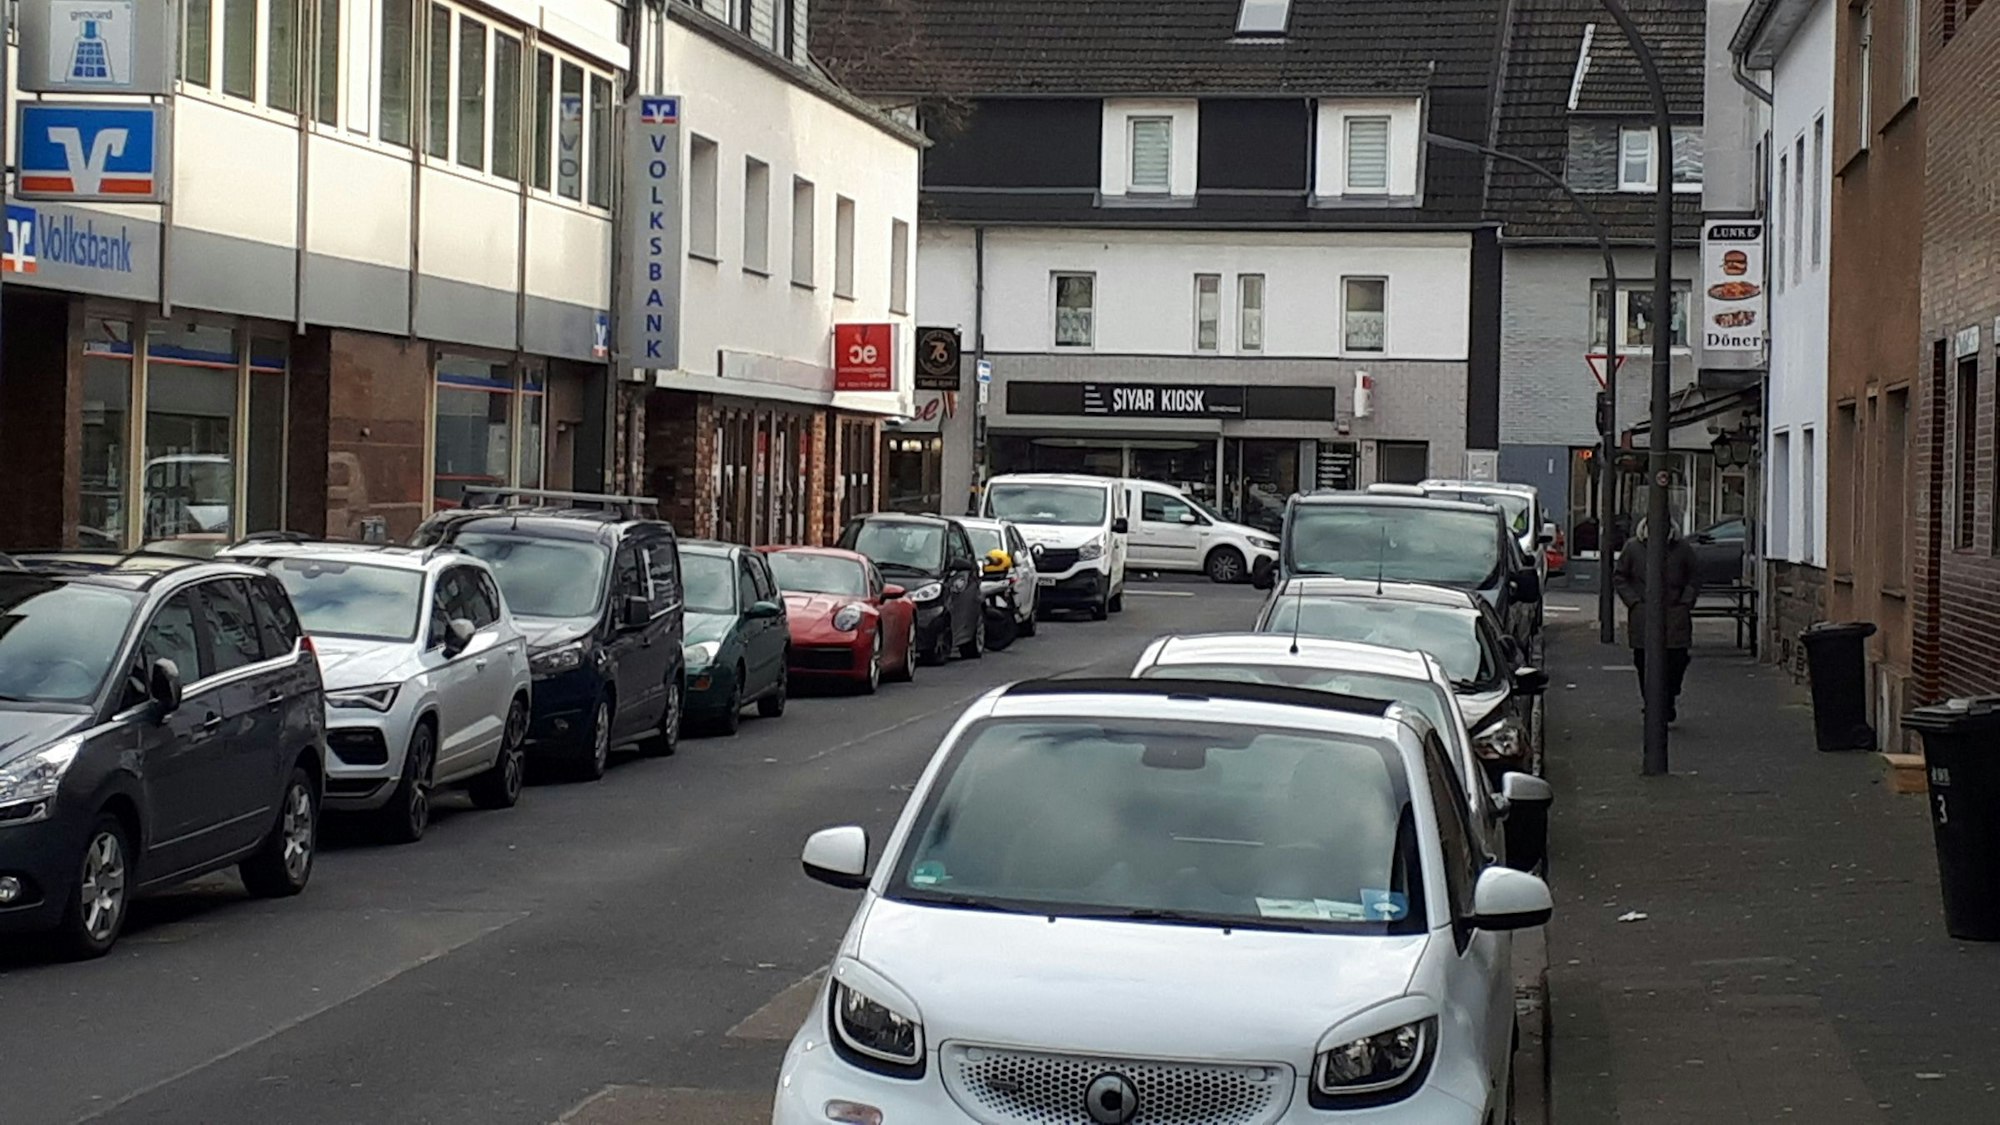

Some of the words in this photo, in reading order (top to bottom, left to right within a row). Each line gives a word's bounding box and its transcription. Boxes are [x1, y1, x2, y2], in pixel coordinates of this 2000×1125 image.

[40, 214, 131, 272] Volksbank
[646, 134, 667, 358] VOLKSBANK
[1707, 333, 1761, 346] Döner
[1161, 389, 1204, 412] KIOSK
[1937, 794, 1948, 824] 3
